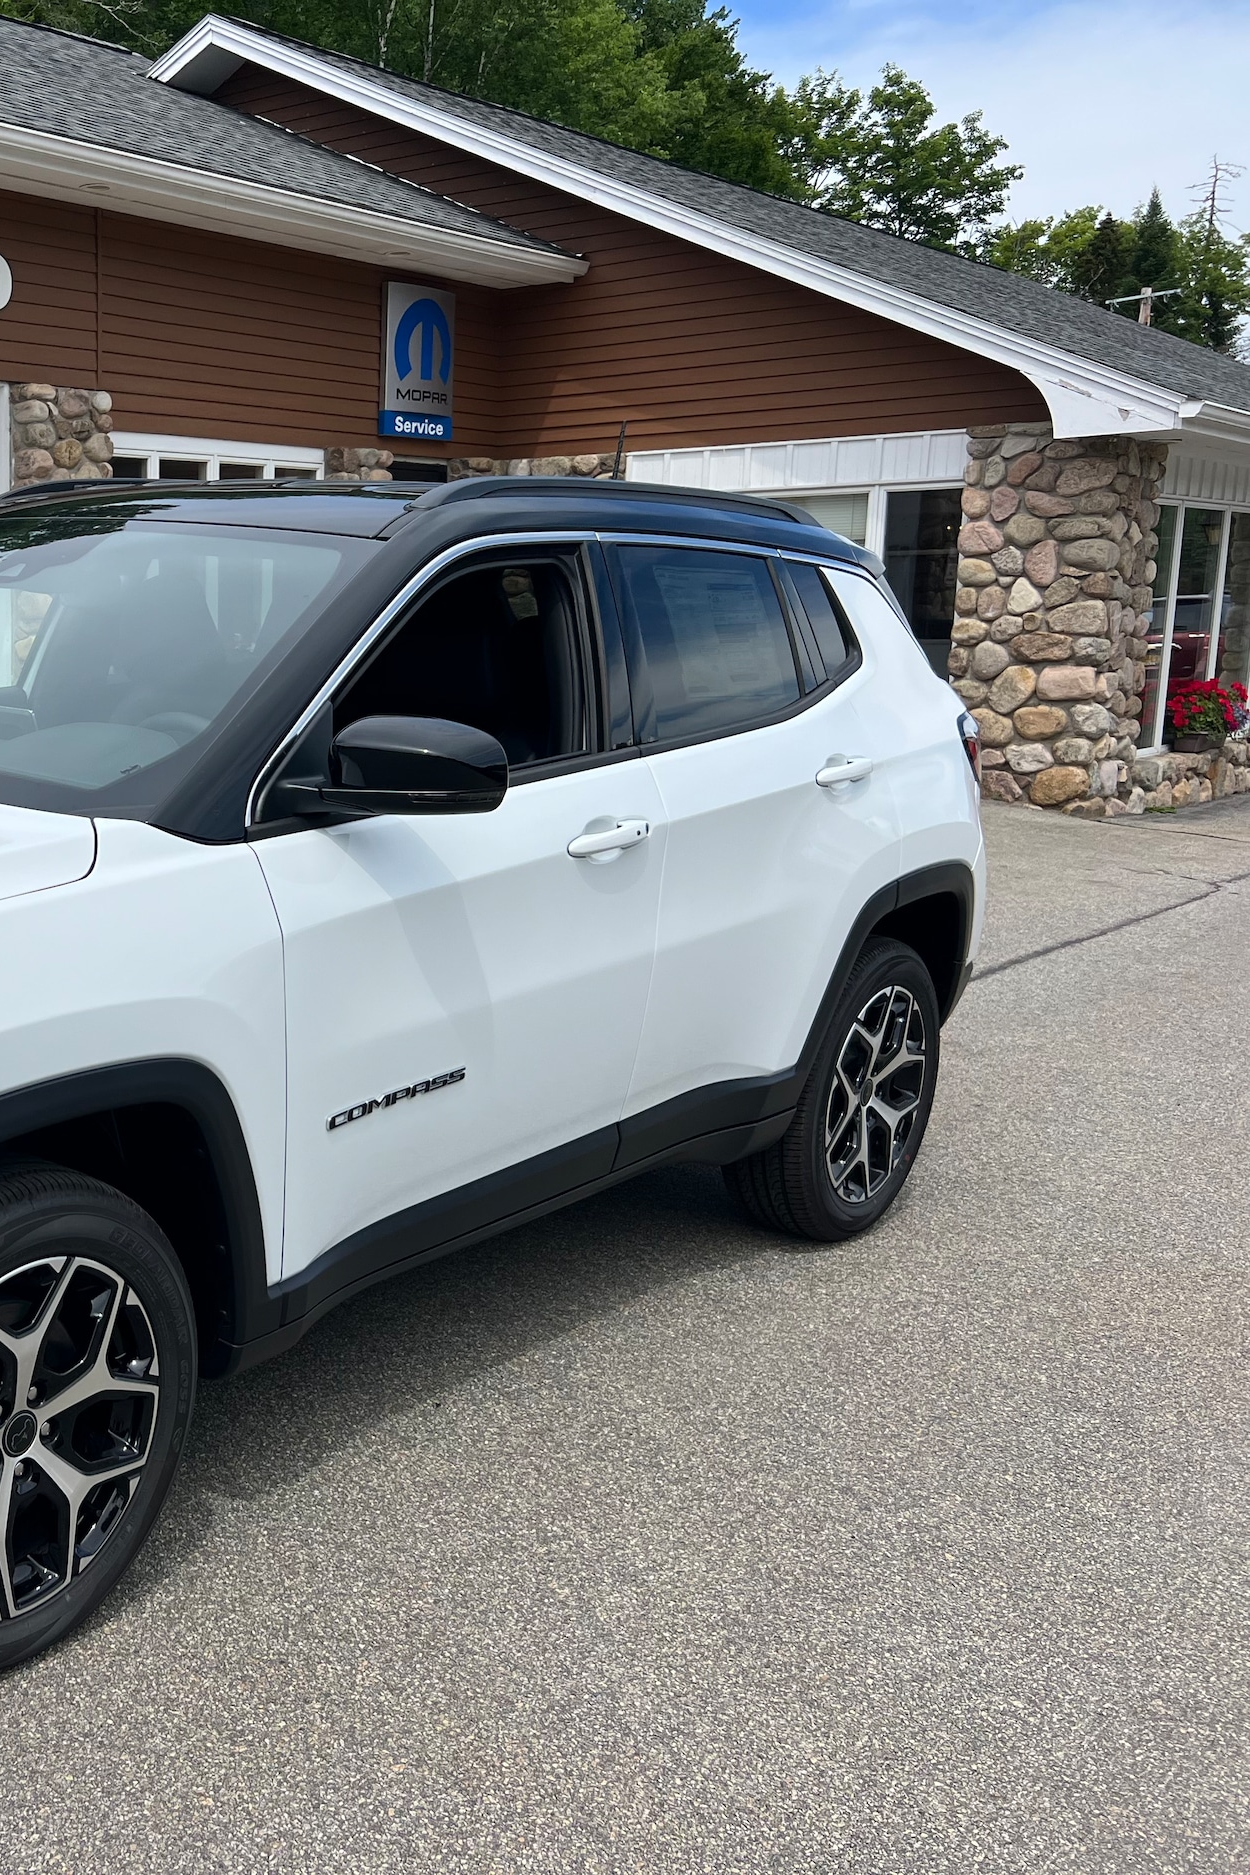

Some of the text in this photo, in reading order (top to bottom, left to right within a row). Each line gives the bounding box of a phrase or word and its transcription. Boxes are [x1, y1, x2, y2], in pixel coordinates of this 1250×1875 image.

[396, 388, 449, 405] MOPAR
[394, 416, 444, 436] Service
[326, 1065, 466, 1131] COMPASS
